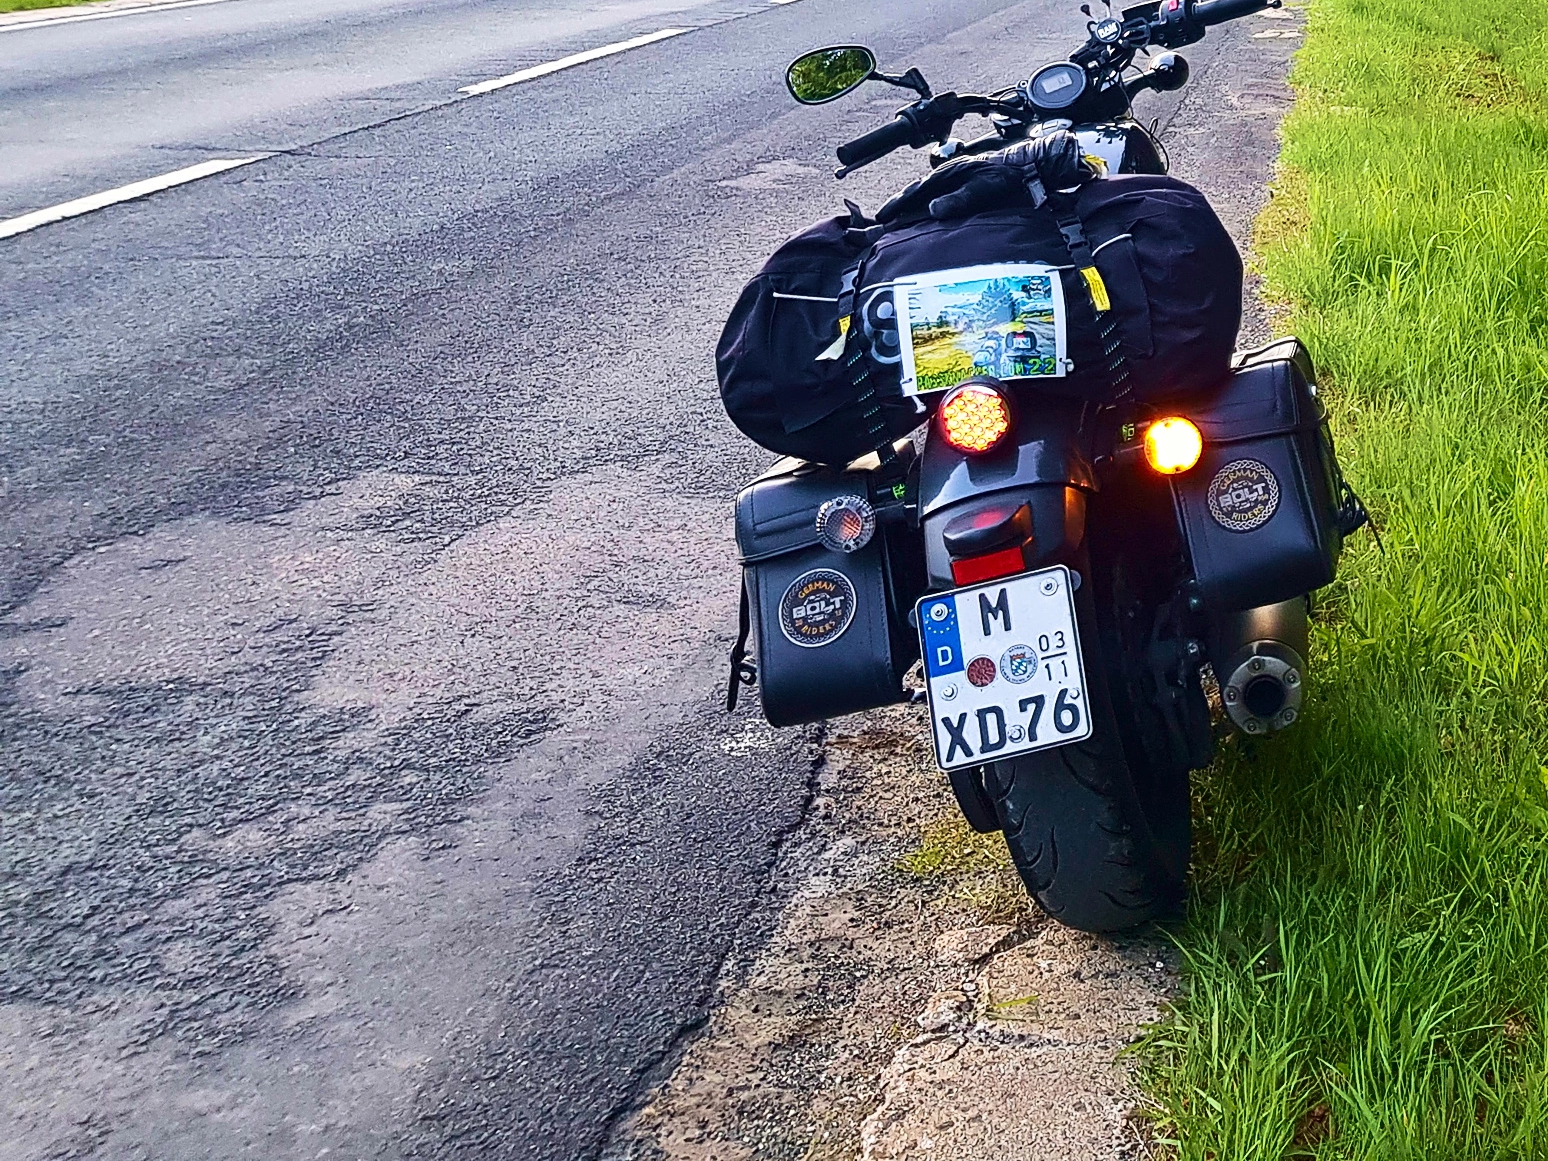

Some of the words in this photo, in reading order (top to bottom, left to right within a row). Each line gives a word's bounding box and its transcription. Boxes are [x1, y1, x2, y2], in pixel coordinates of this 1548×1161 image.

[1220, 469, 1259, 490] GERMAN
[1218, 483, 1266, 507] BOLT
[1232, 504, 1264, 521] RIDERS
[798, 581, 836, 599] GERMAN
[792, 595, 845, 619] BOLT
[978, 587, 1012, 637] M
[801, 620, 836, 635] RIDERS
[1038, 630, 1066, 652] 03
[937, 646, 953, 666] D
[1044, 659, 1068, 682] 11
